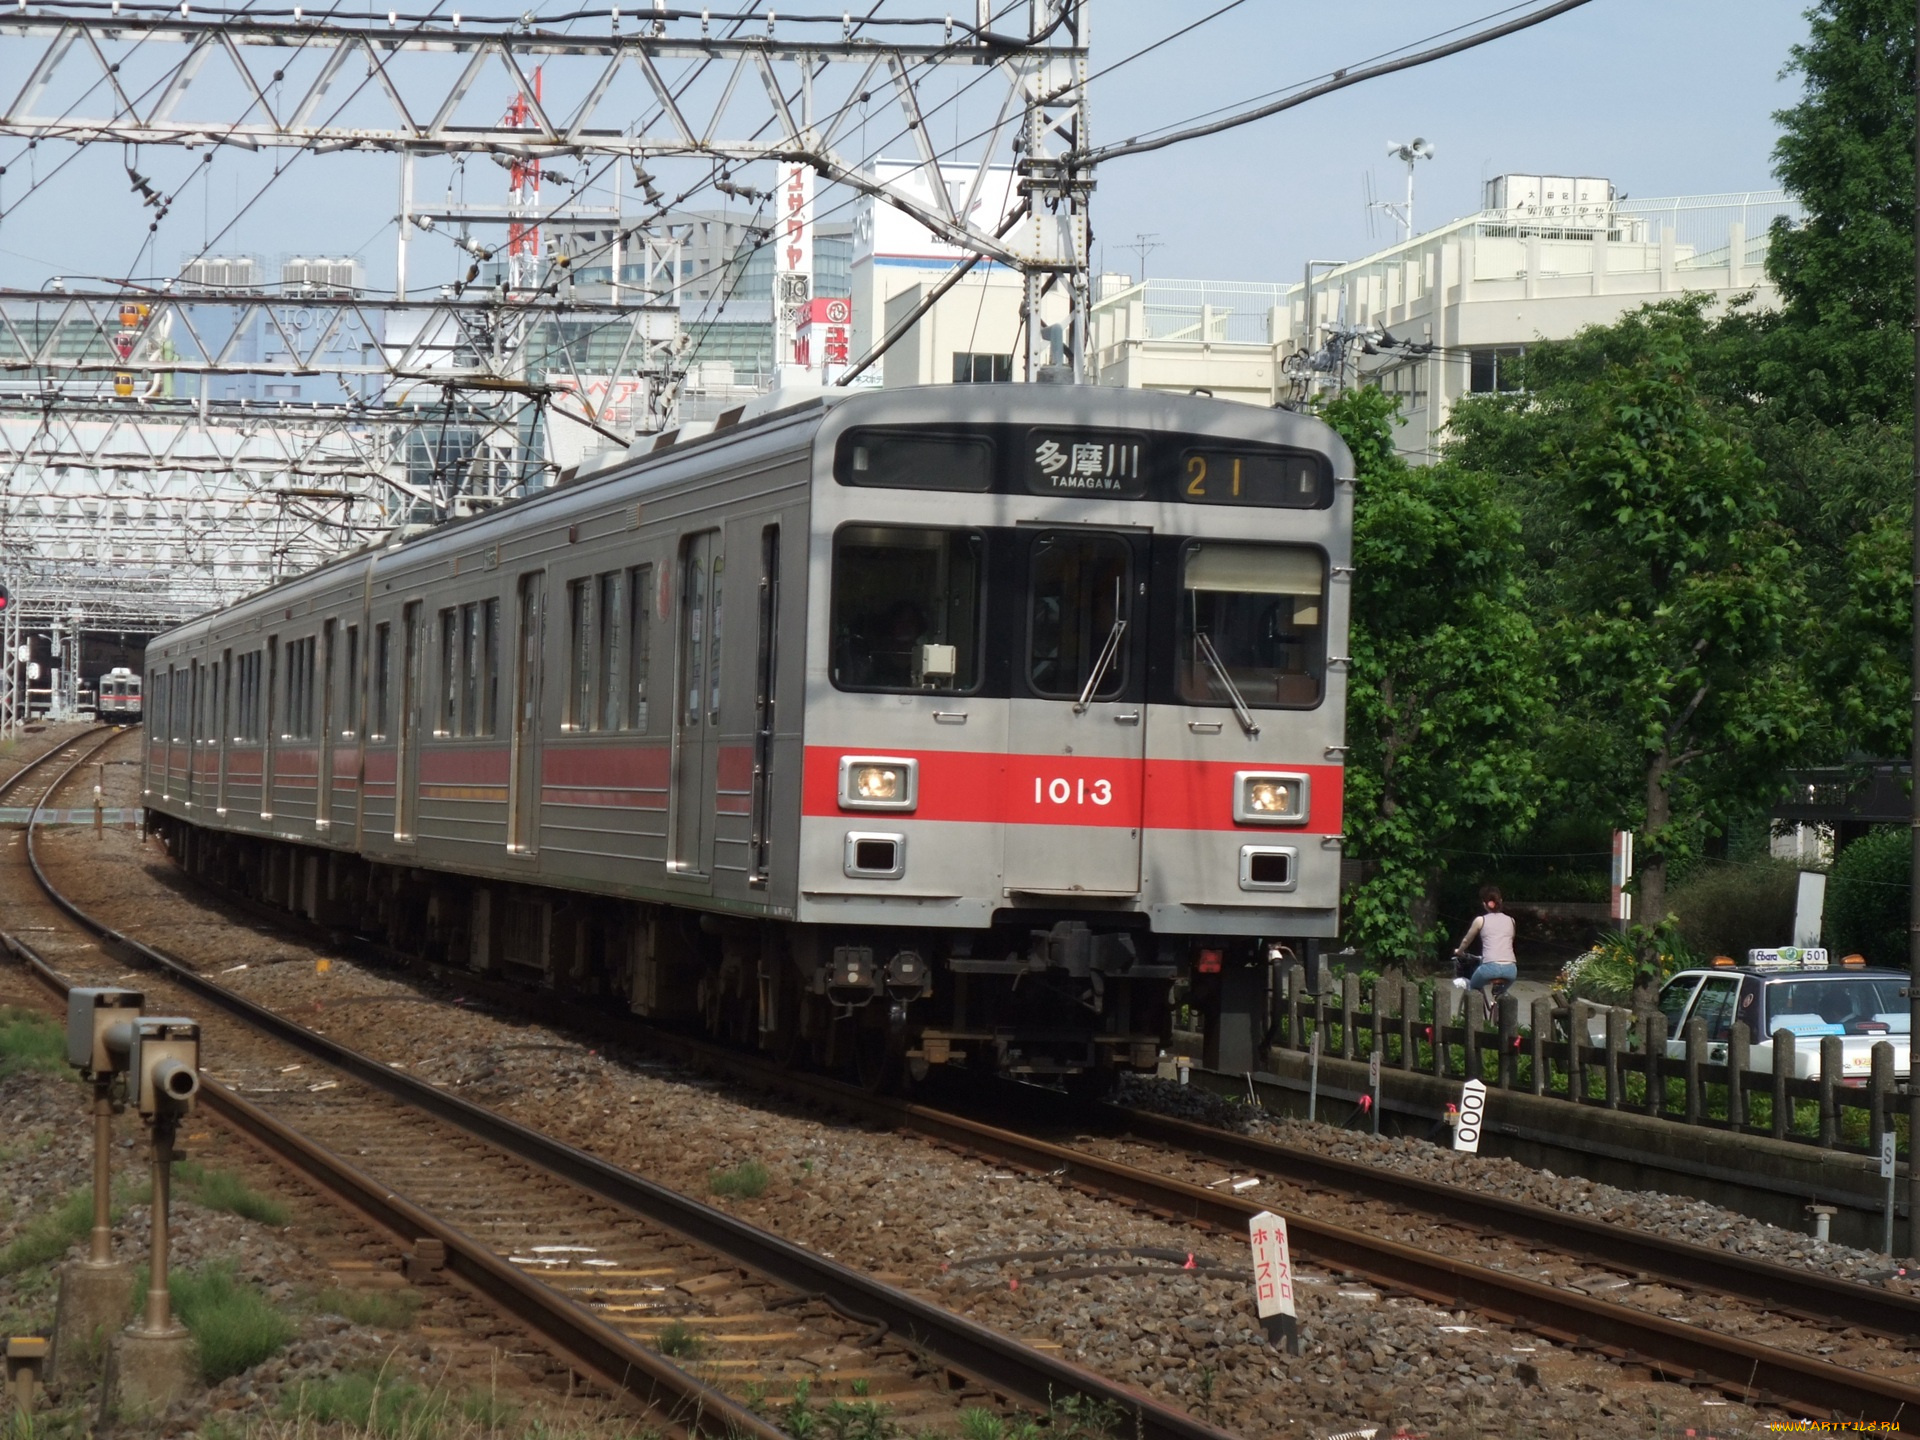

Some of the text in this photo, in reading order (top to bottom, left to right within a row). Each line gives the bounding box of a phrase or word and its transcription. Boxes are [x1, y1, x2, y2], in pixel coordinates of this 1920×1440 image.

[786, 167, 804, 270] ユザワヤ
[1035, 439, 1139, 478] 多摩川
[1050, 475, 1122, 490] TAMAGAWA
[1035, 777, 1112, 805] 1013
[1806, 950, 1826, 961] 501
[1458, 1086, 1486, 1143] 1000
[1883, 1147, 1892, 1165] S
